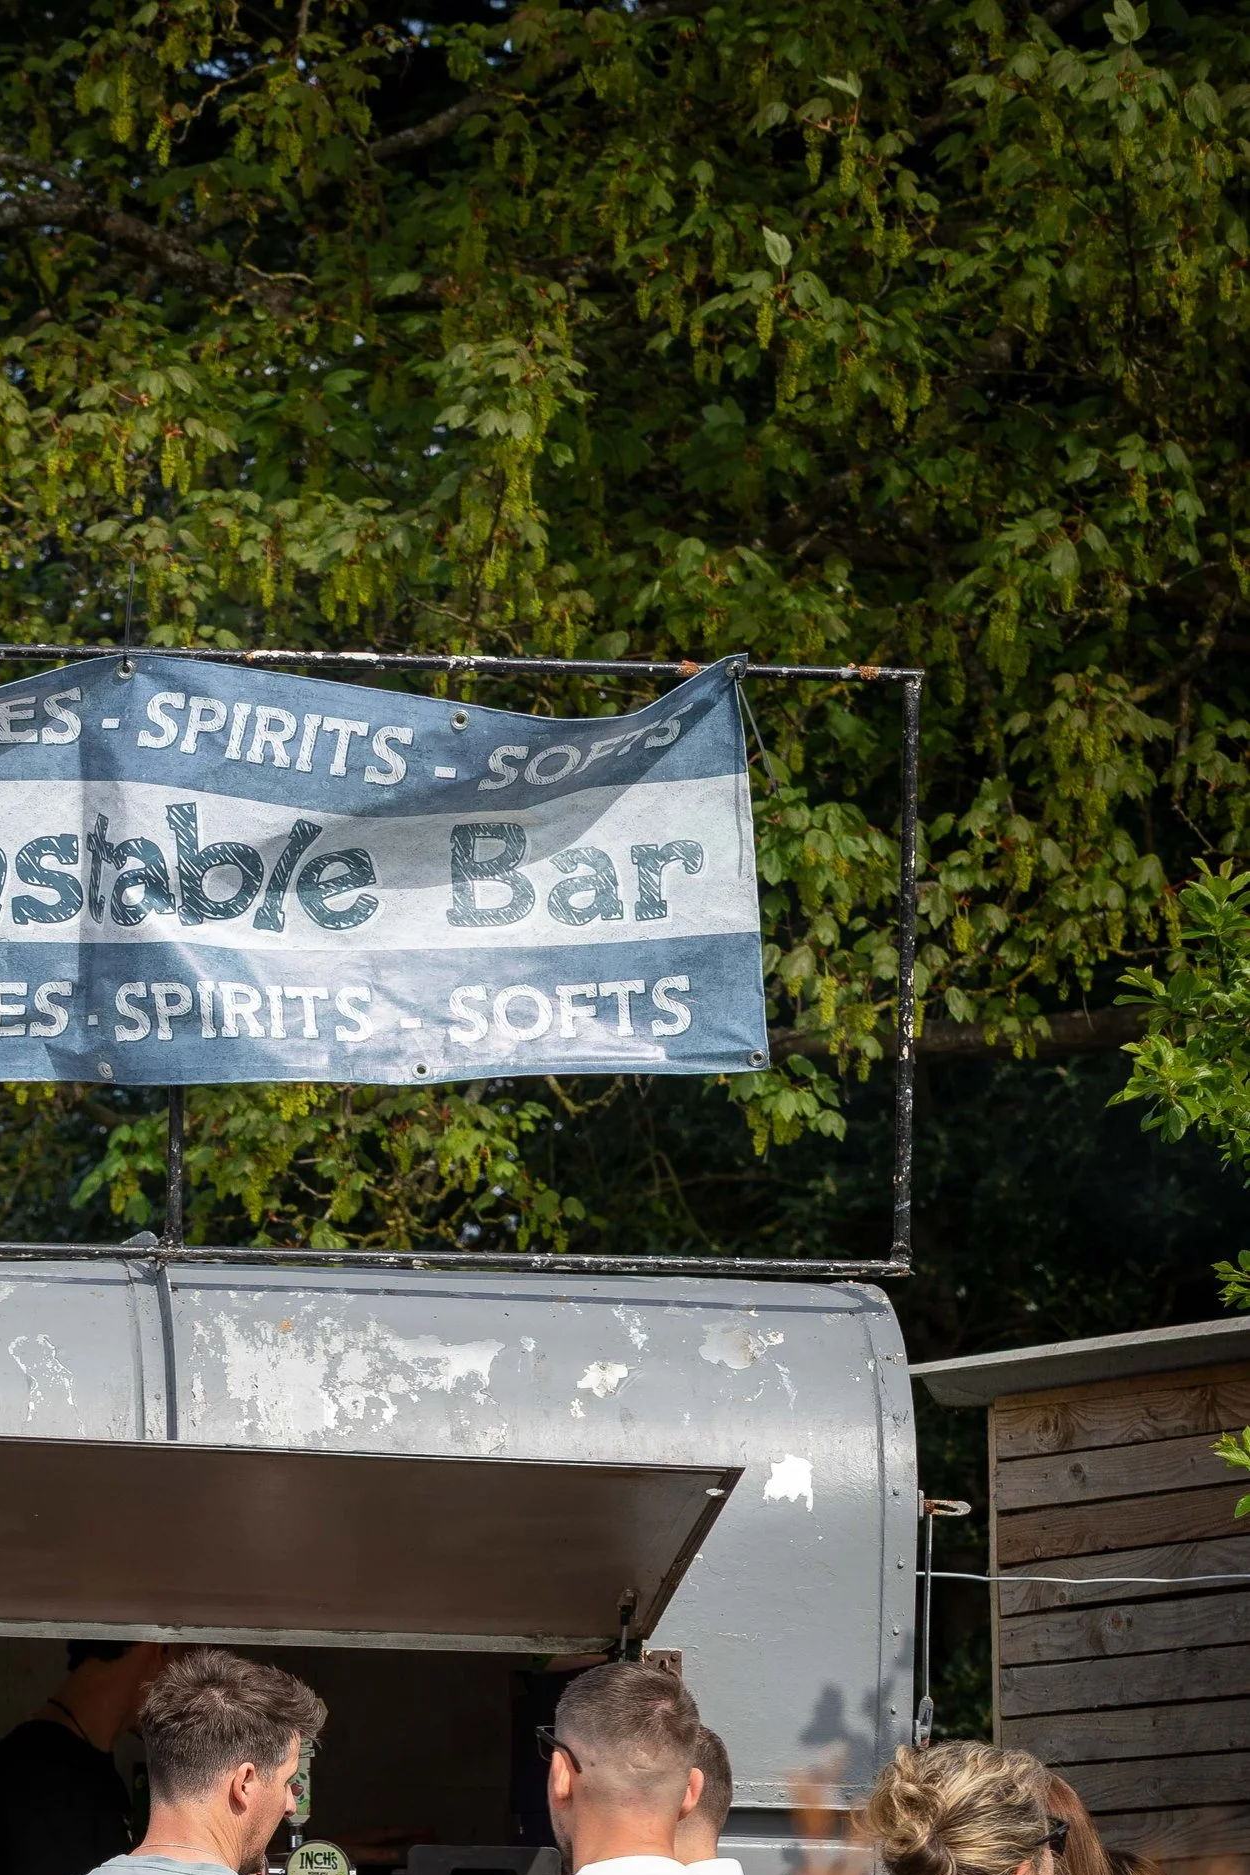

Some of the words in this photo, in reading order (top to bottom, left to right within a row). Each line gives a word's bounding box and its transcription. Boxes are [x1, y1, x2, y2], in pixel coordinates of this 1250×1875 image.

[137, 691, 413, 785] SPIRITS
[478, 703, 693, 791] SOFTS
[447, 822, 704, 927] Bar
[115, 981, 371, 1043] SPIRITS
[448, 975, 692, 1043] SOFTS
